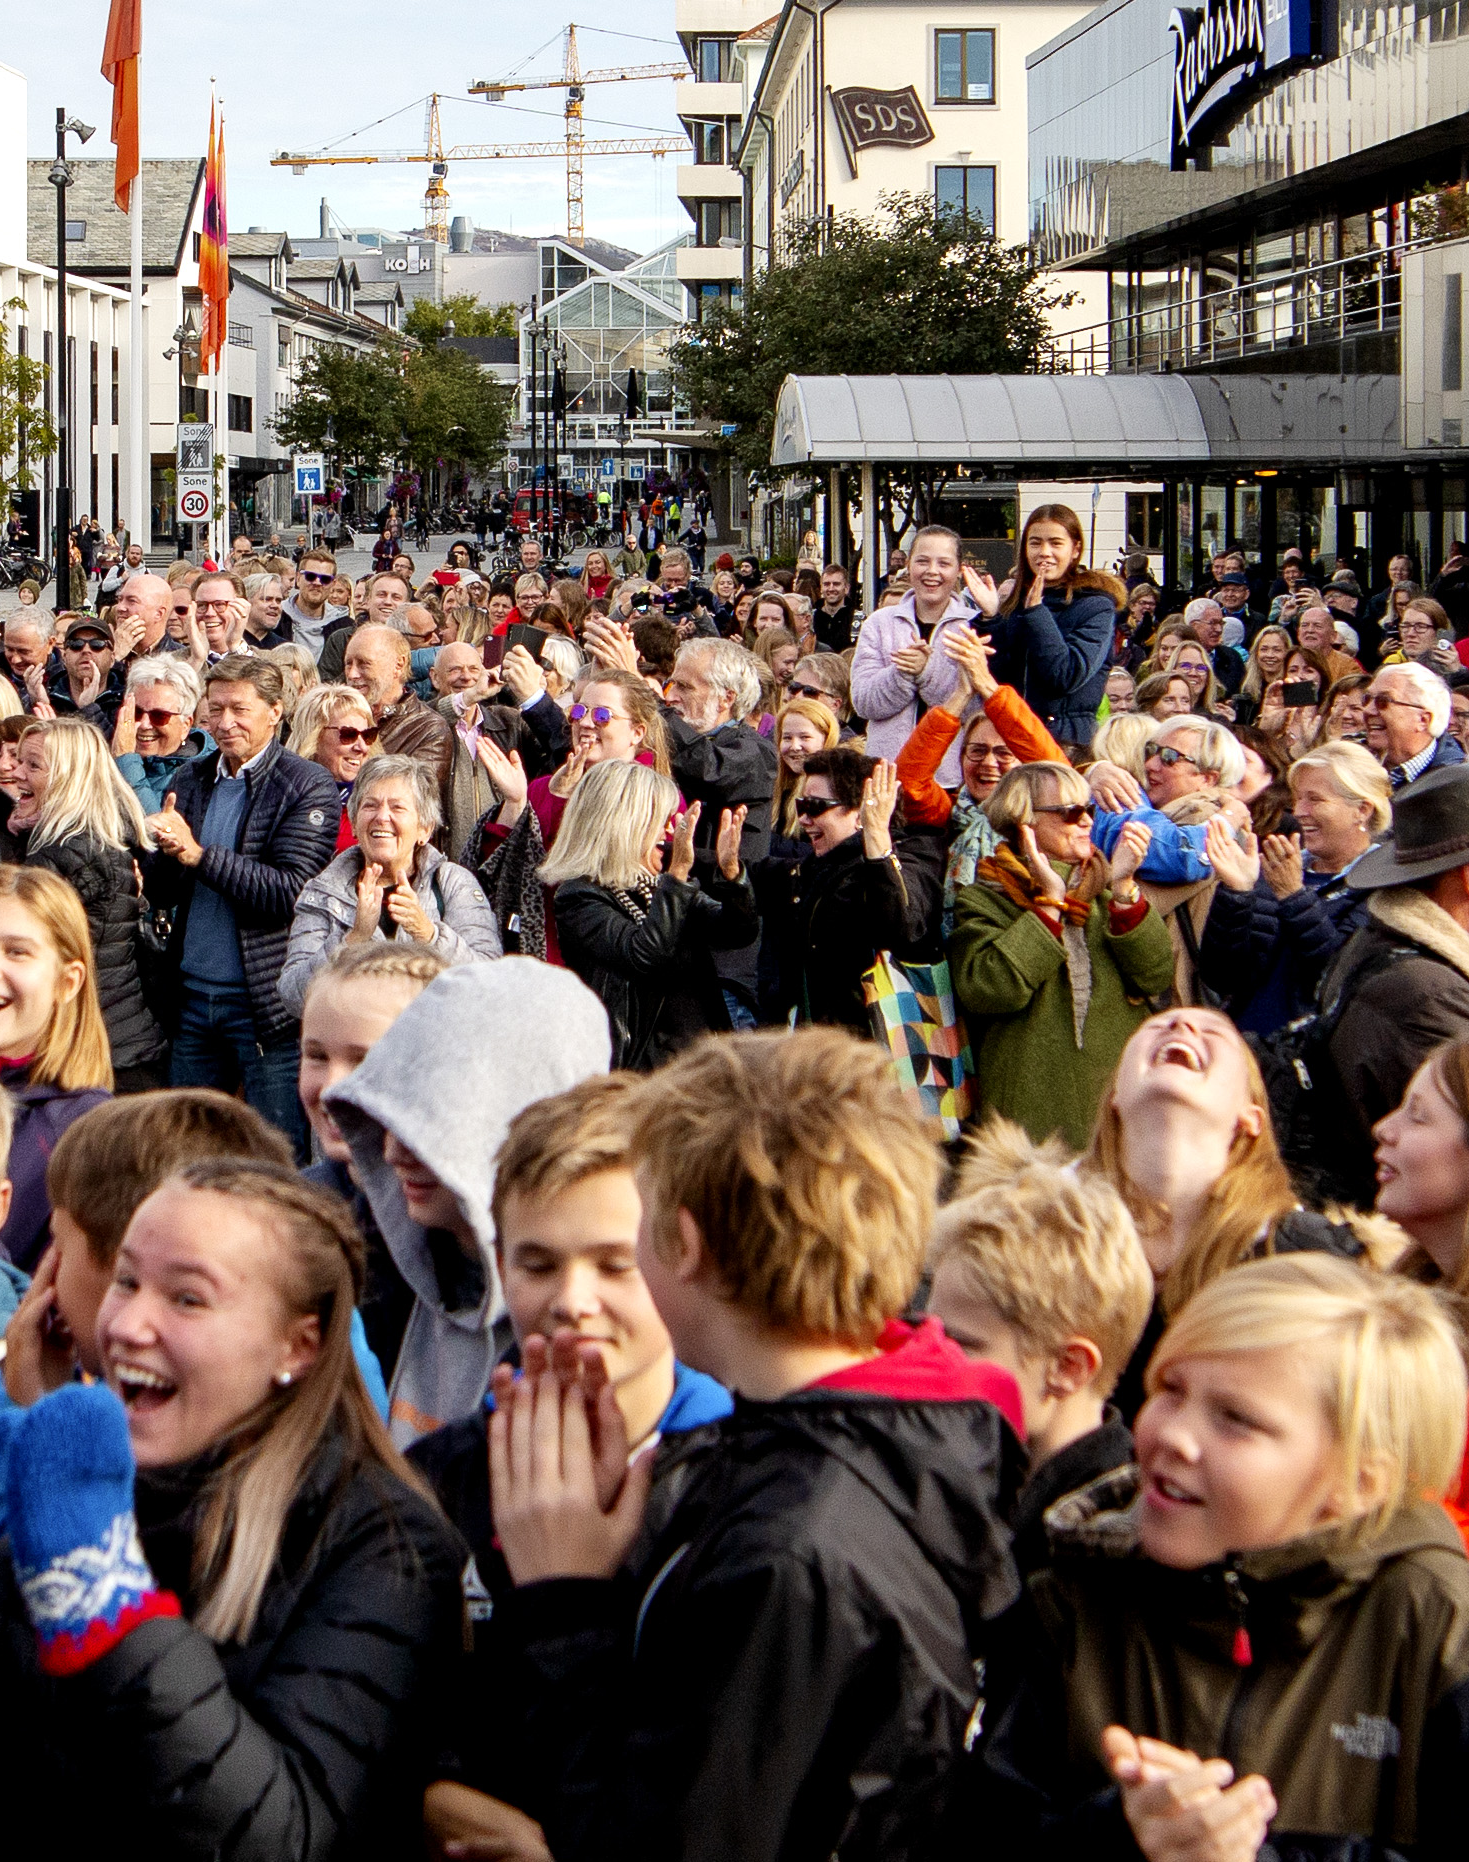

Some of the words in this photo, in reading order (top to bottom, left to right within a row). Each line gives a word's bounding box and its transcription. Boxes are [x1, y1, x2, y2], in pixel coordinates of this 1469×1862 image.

[1168, 0, 1264, 147] Radisson
[855, 102, 917, 133] SDS
[384, 258, 431, 271] KOCH
[298, 456, 319, 465] Sone
[183, 476, 208, 486] Sone
[186, 497, 204, 511] 30
